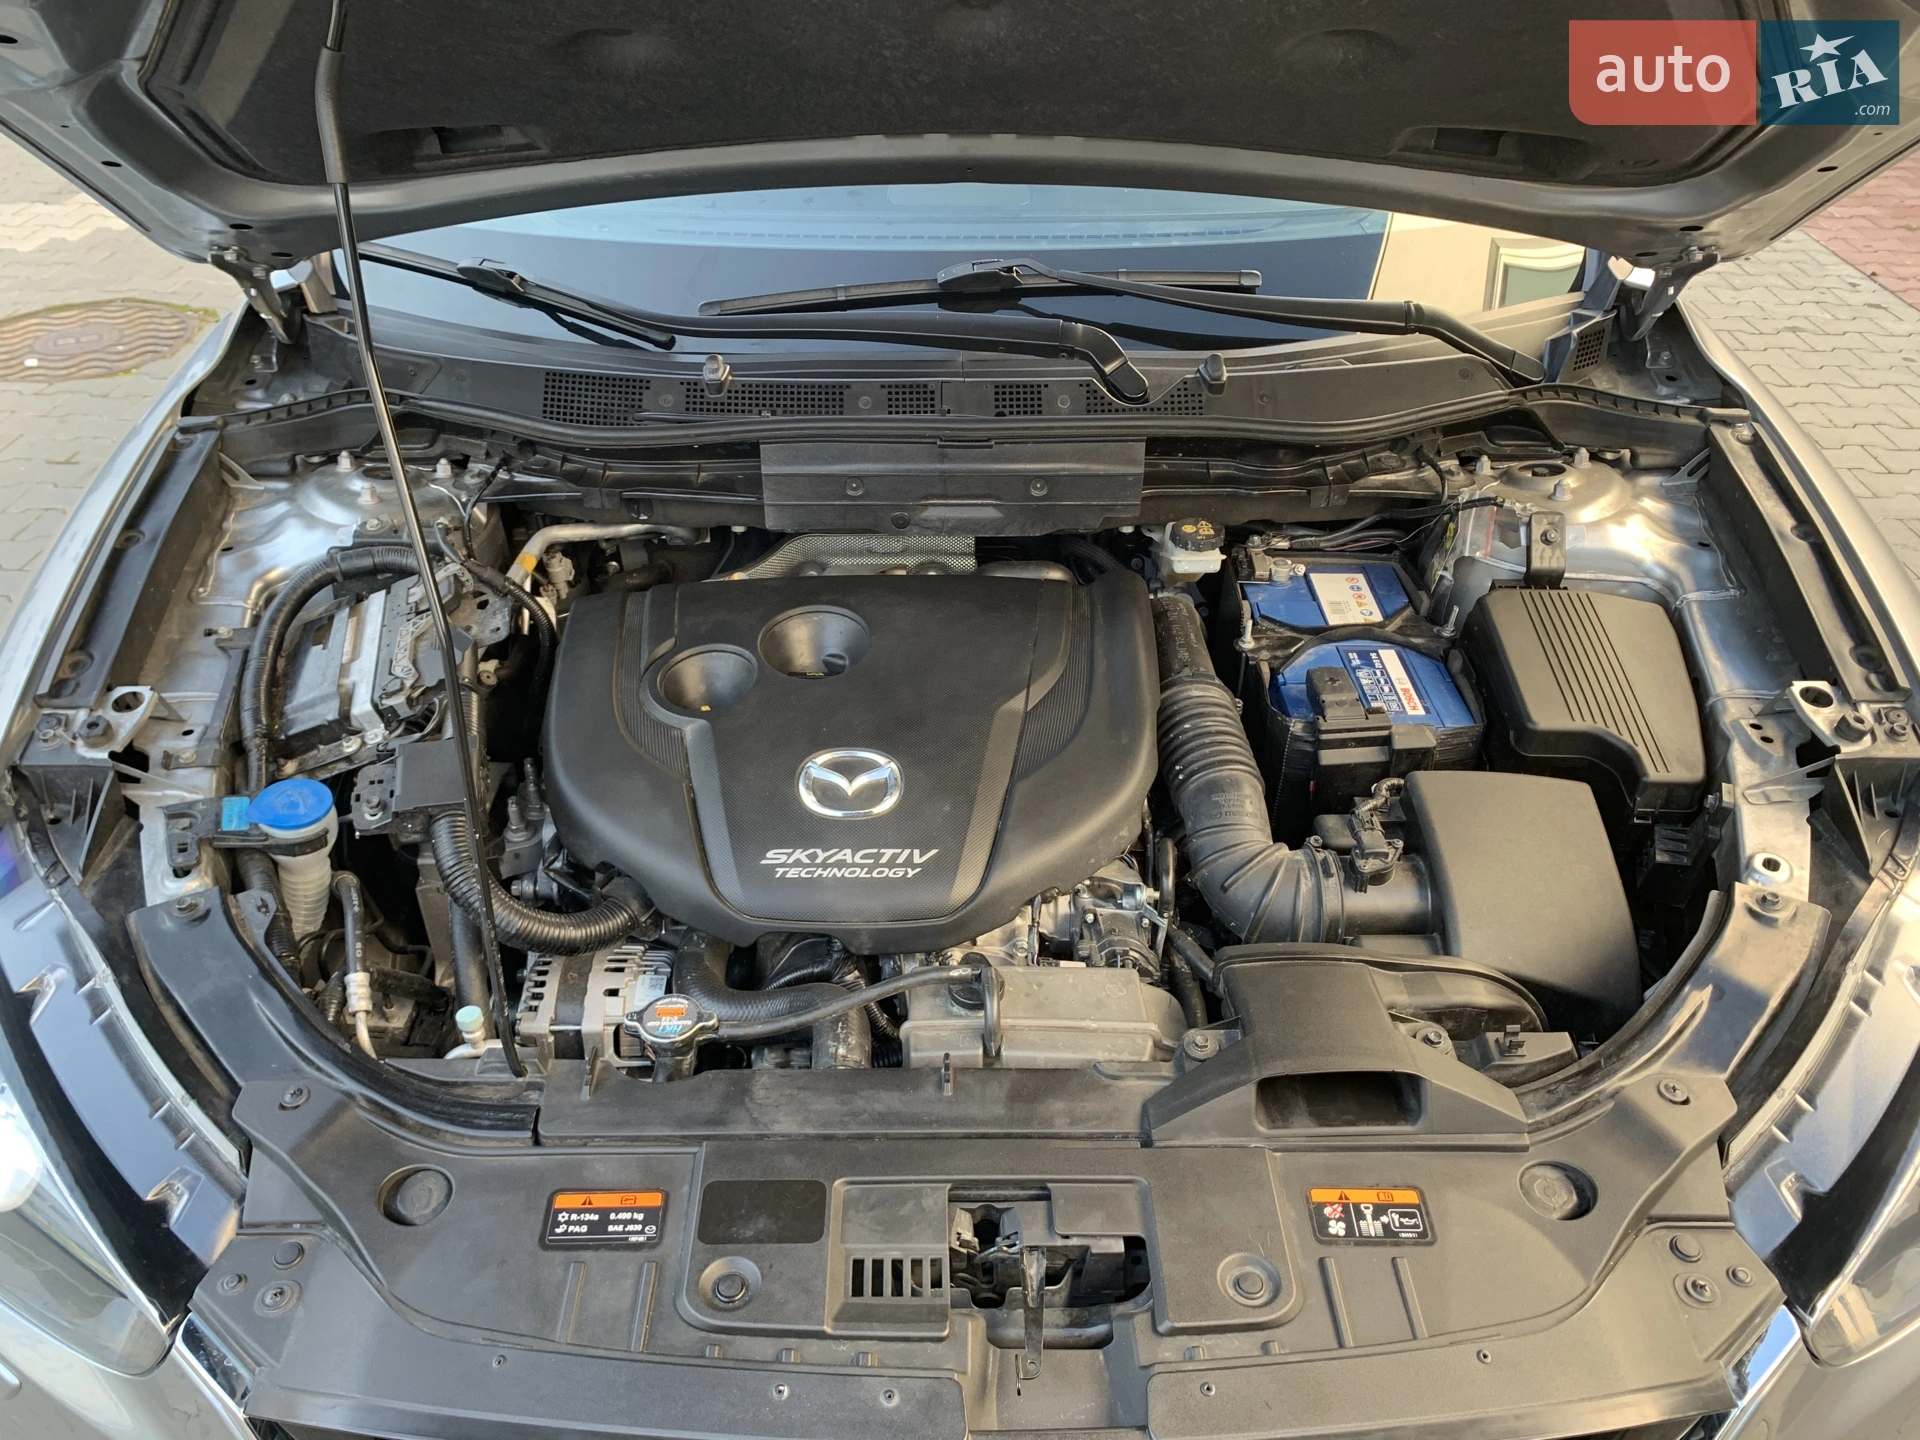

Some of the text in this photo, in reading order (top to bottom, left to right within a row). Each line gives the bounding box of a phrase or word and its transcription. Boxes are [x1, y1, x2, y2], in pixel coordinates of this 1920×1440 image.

[1400, 687, 1420, 711] BOSCH
[760, 848, 939, 865] SKYACTIV
[774, 867, 922, 878] TECHNOLOGY
[656, 1024, 683, 1035] HKT
[570, 1213, 599, 1221] R-134a
[633, 1211, 645, 1221] kg
[567, 1225, 588, 1233] PAG
[607, 1224, 624, 1232] SAE
